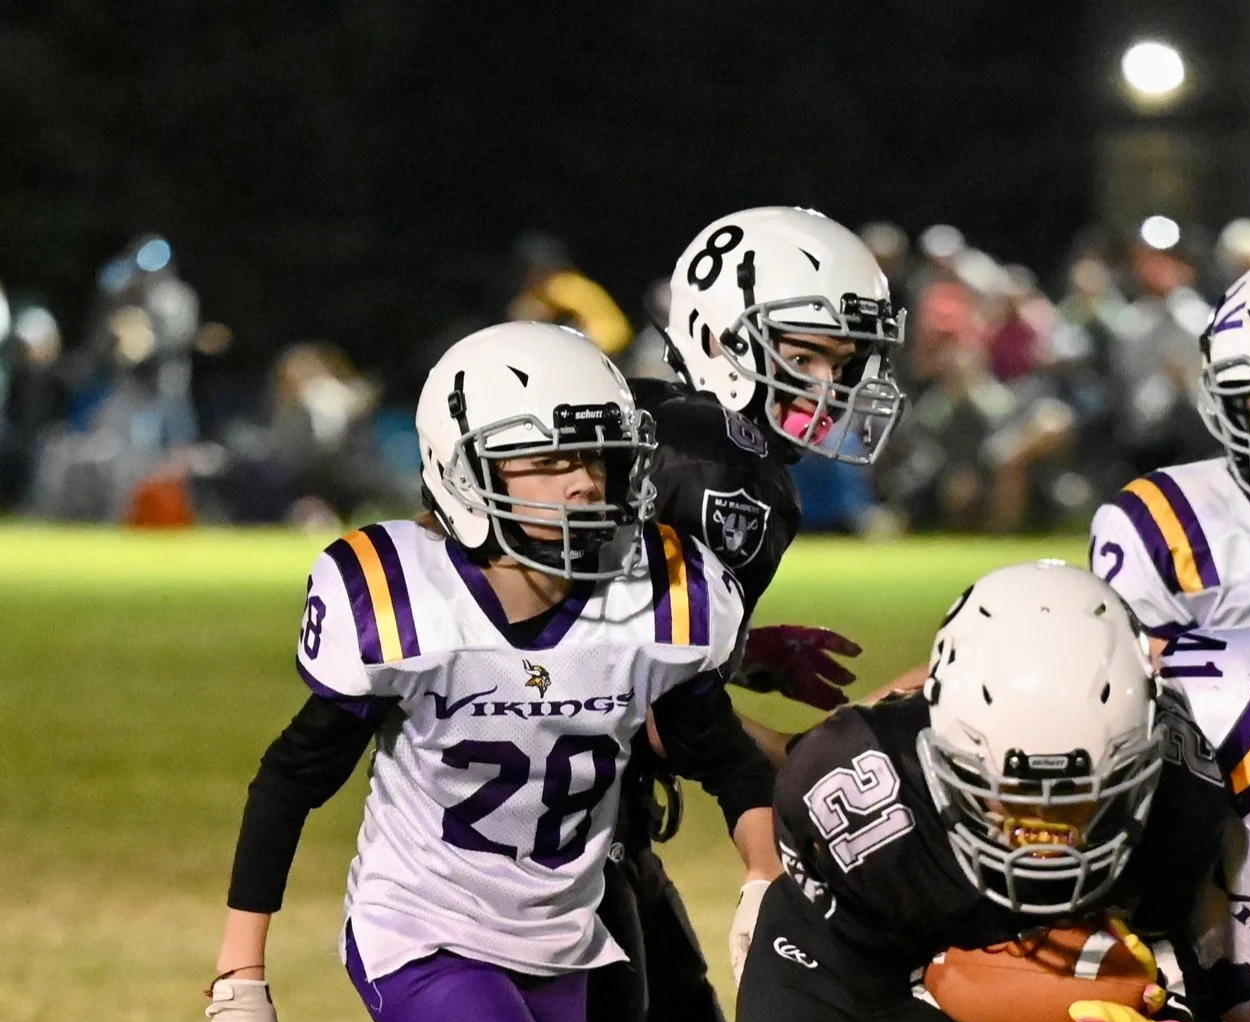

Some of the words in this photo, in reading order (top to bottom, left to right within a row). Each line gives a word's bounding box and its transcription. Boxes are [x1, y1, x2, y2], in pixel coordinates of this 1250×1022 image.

[687, 225, 744, 291] 8
[575, 409, 603, 420] schutt
[1089, 536, 1124, 585] 2
[441, 734, 620, 870] 28
[803, 750, 916, 873] 21
